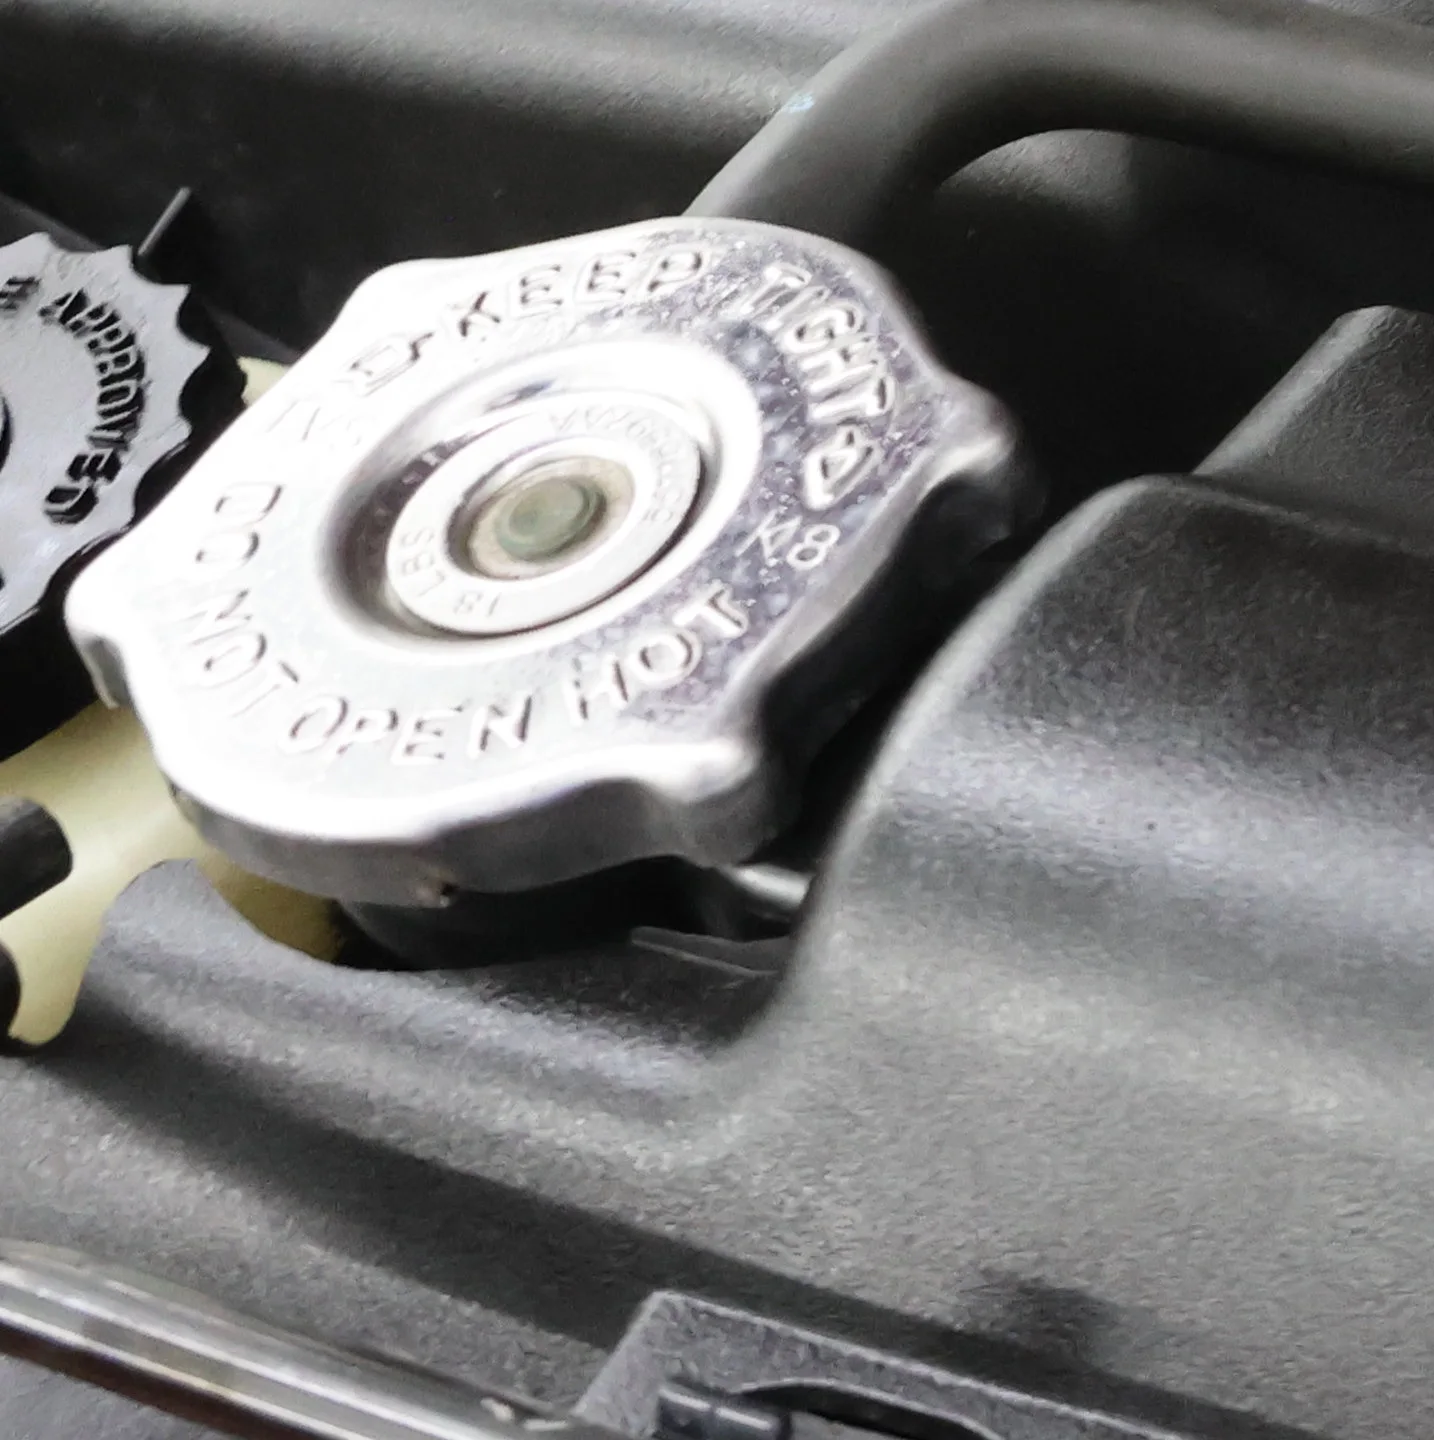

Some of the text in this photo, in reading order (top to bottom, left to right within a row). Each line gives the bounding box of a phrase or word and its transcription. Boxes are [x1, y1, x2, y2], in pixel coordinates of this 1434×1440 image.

[39, 287, 146, 525] APPROVED
[446, 248, 896, 422] KEEP TIGHT
[178, 480, 750, 768] DO NOT OPEN HOT
[400, 524, 447, 599] LBS
